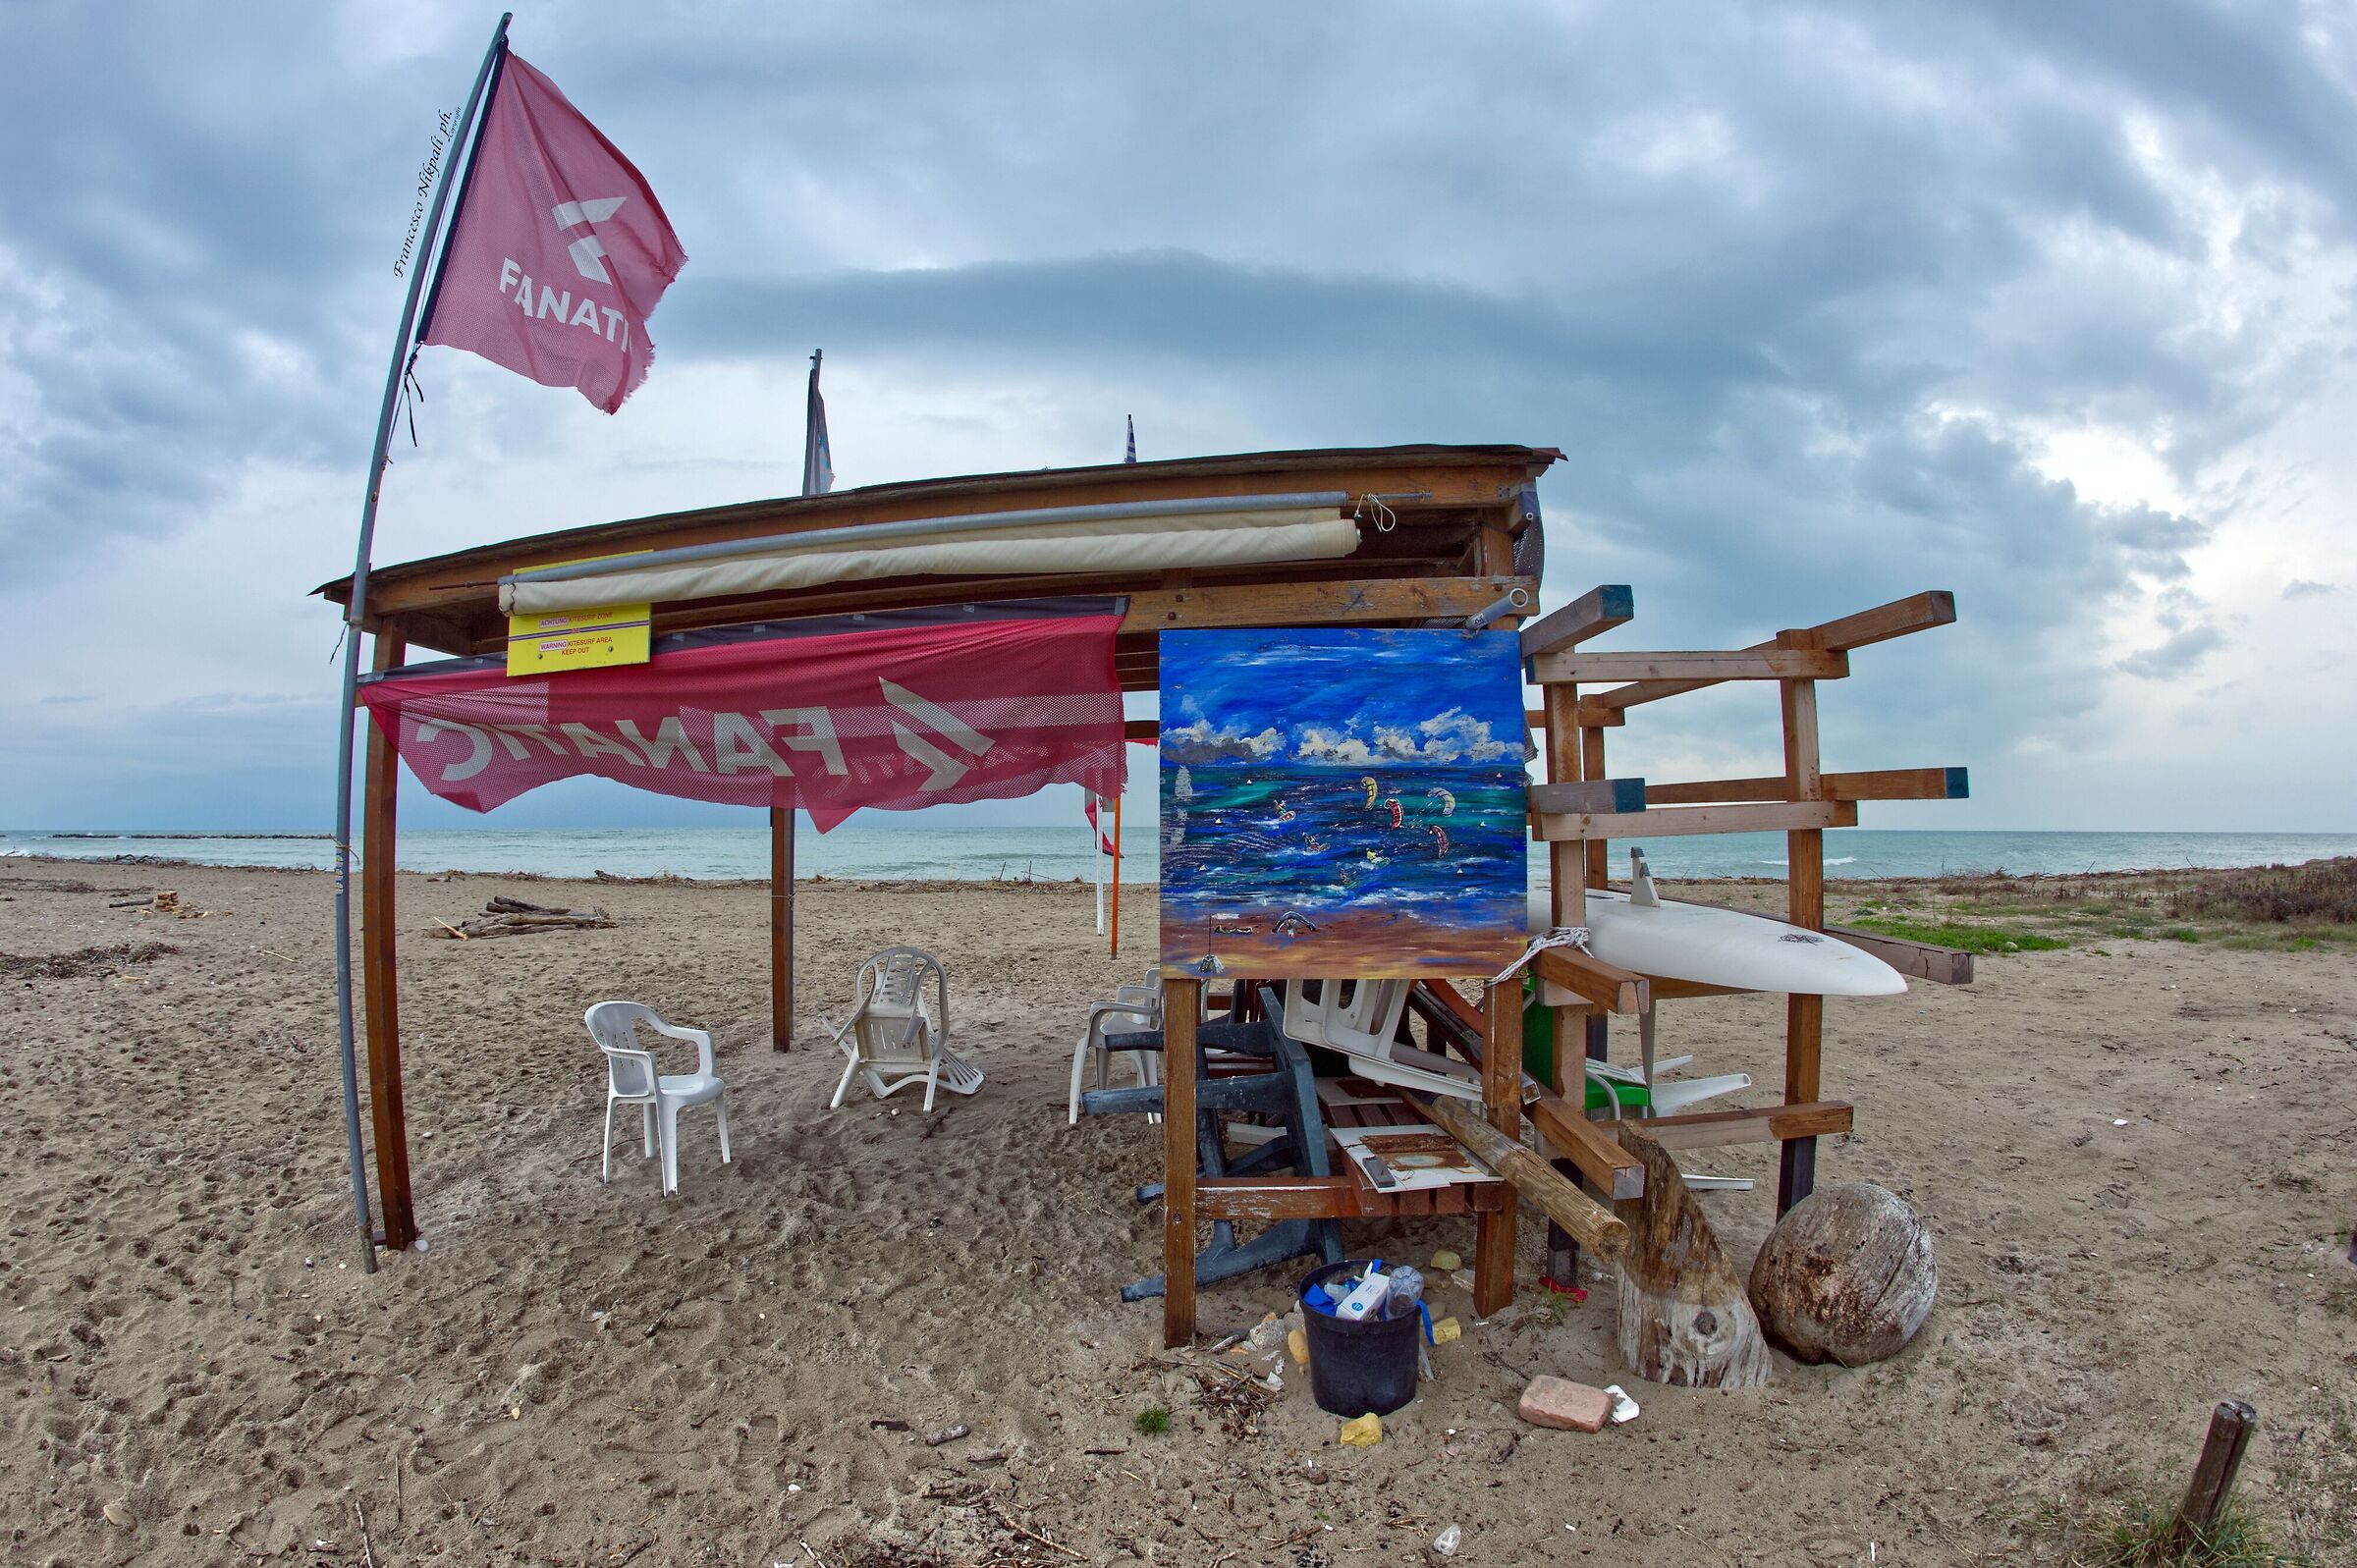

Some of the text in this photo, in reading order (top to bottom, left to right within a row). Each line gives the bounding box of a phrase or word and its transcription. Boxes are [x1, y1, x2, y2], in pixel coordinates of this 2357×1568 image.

[499, 256, 631, 353] FANATI
[540, 617, 568, 626] ACHTUNG
[540, 641, 567, 650] WARNING
[567, 638, 595, 647] KITESURF
